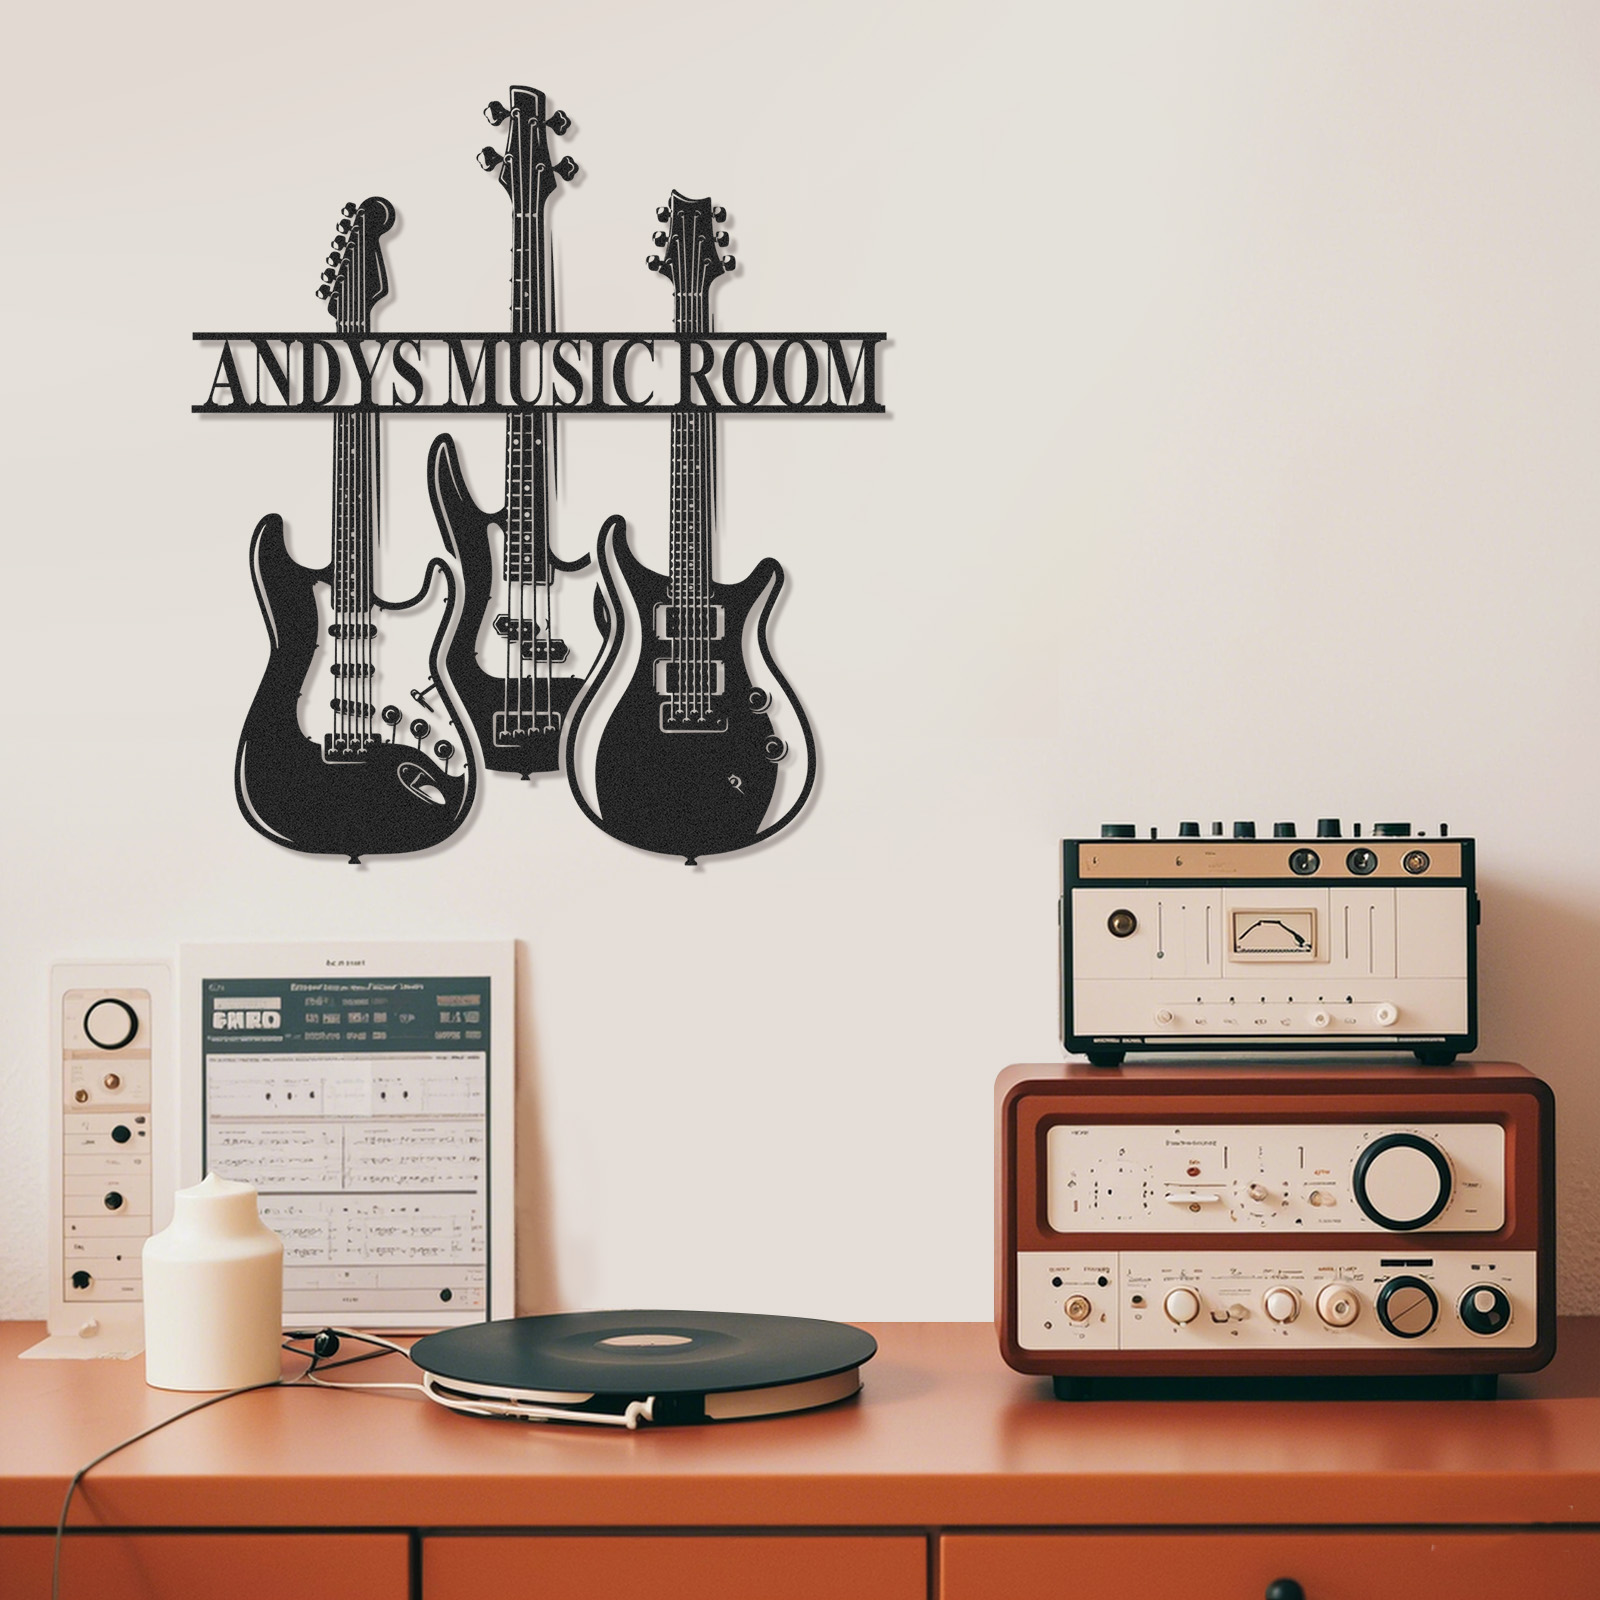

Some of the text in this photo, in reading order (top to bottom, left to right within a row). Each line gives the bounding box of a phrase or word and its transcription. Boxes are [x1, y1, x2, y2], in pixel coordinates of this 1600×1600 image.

[203, 338, 882, 407] ANDYS MUSIC ROOM
